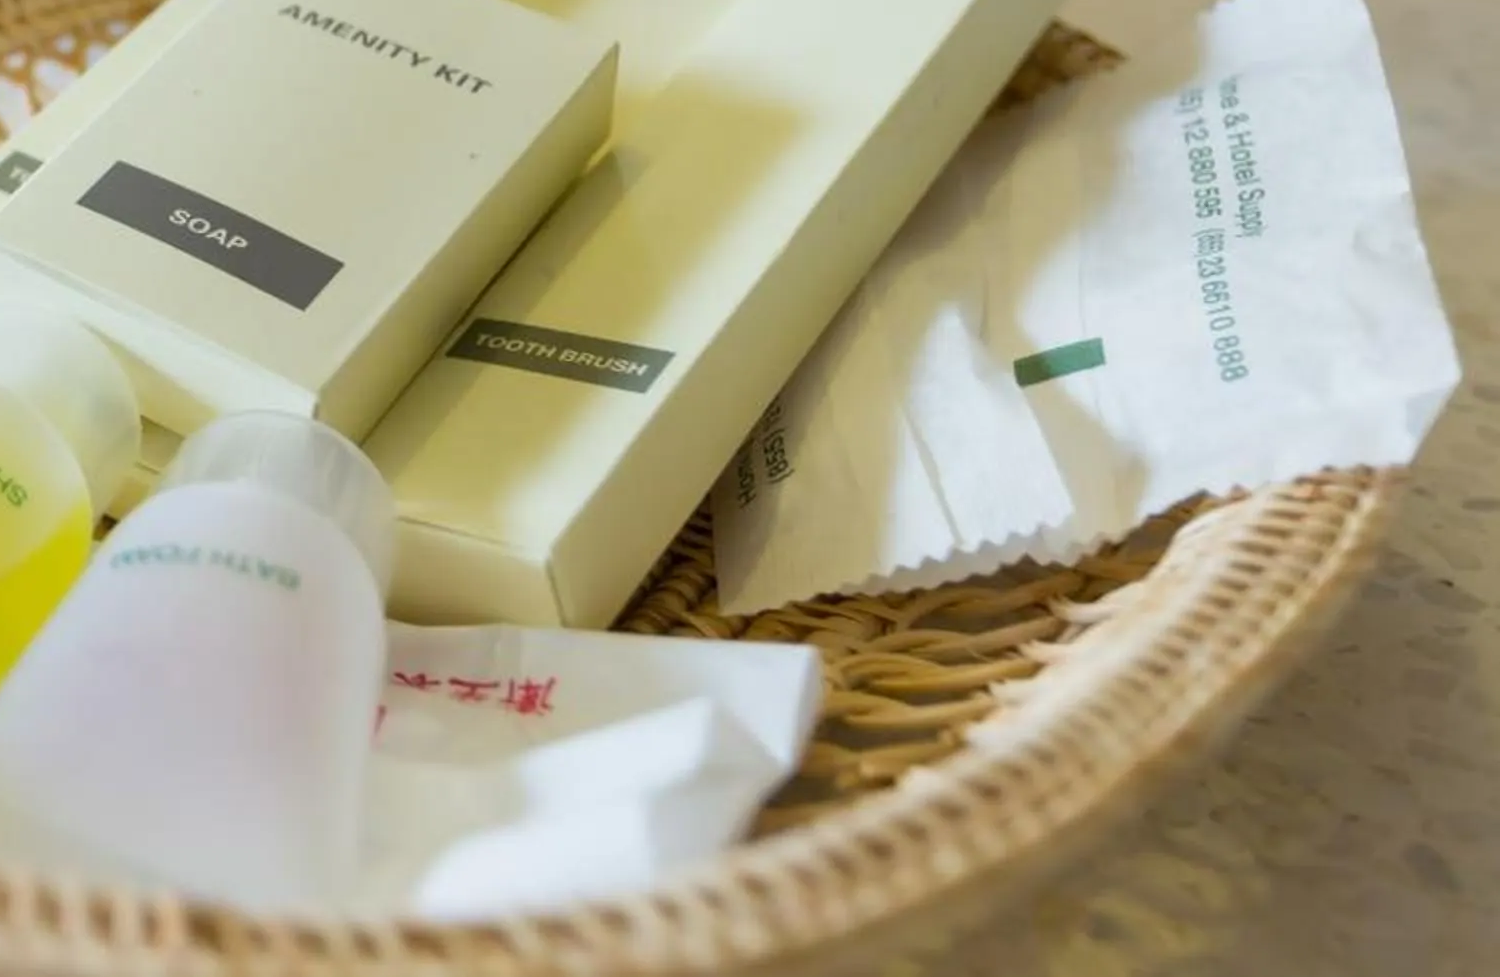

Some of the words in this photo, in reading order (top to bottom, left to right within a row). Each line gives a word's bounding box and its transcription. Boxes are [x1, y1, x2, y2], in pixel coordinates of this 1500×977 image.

[278, 2, 432, 69] AMENITY
[432, 62, 494, 97] KIT
[1223, 112, 1250, 130] &
[1188, 146, 1217, 184] 880
[1226, 131, 1263, 186] Hotel
[1193, 186, 1223, 218] 595
[168, 207, 249, 254] SOAP
[475, 332, 557, 358] TOOTH
[558, 349, 650, 377] BRUSH
[1212, 335, 1250, 383] 888
